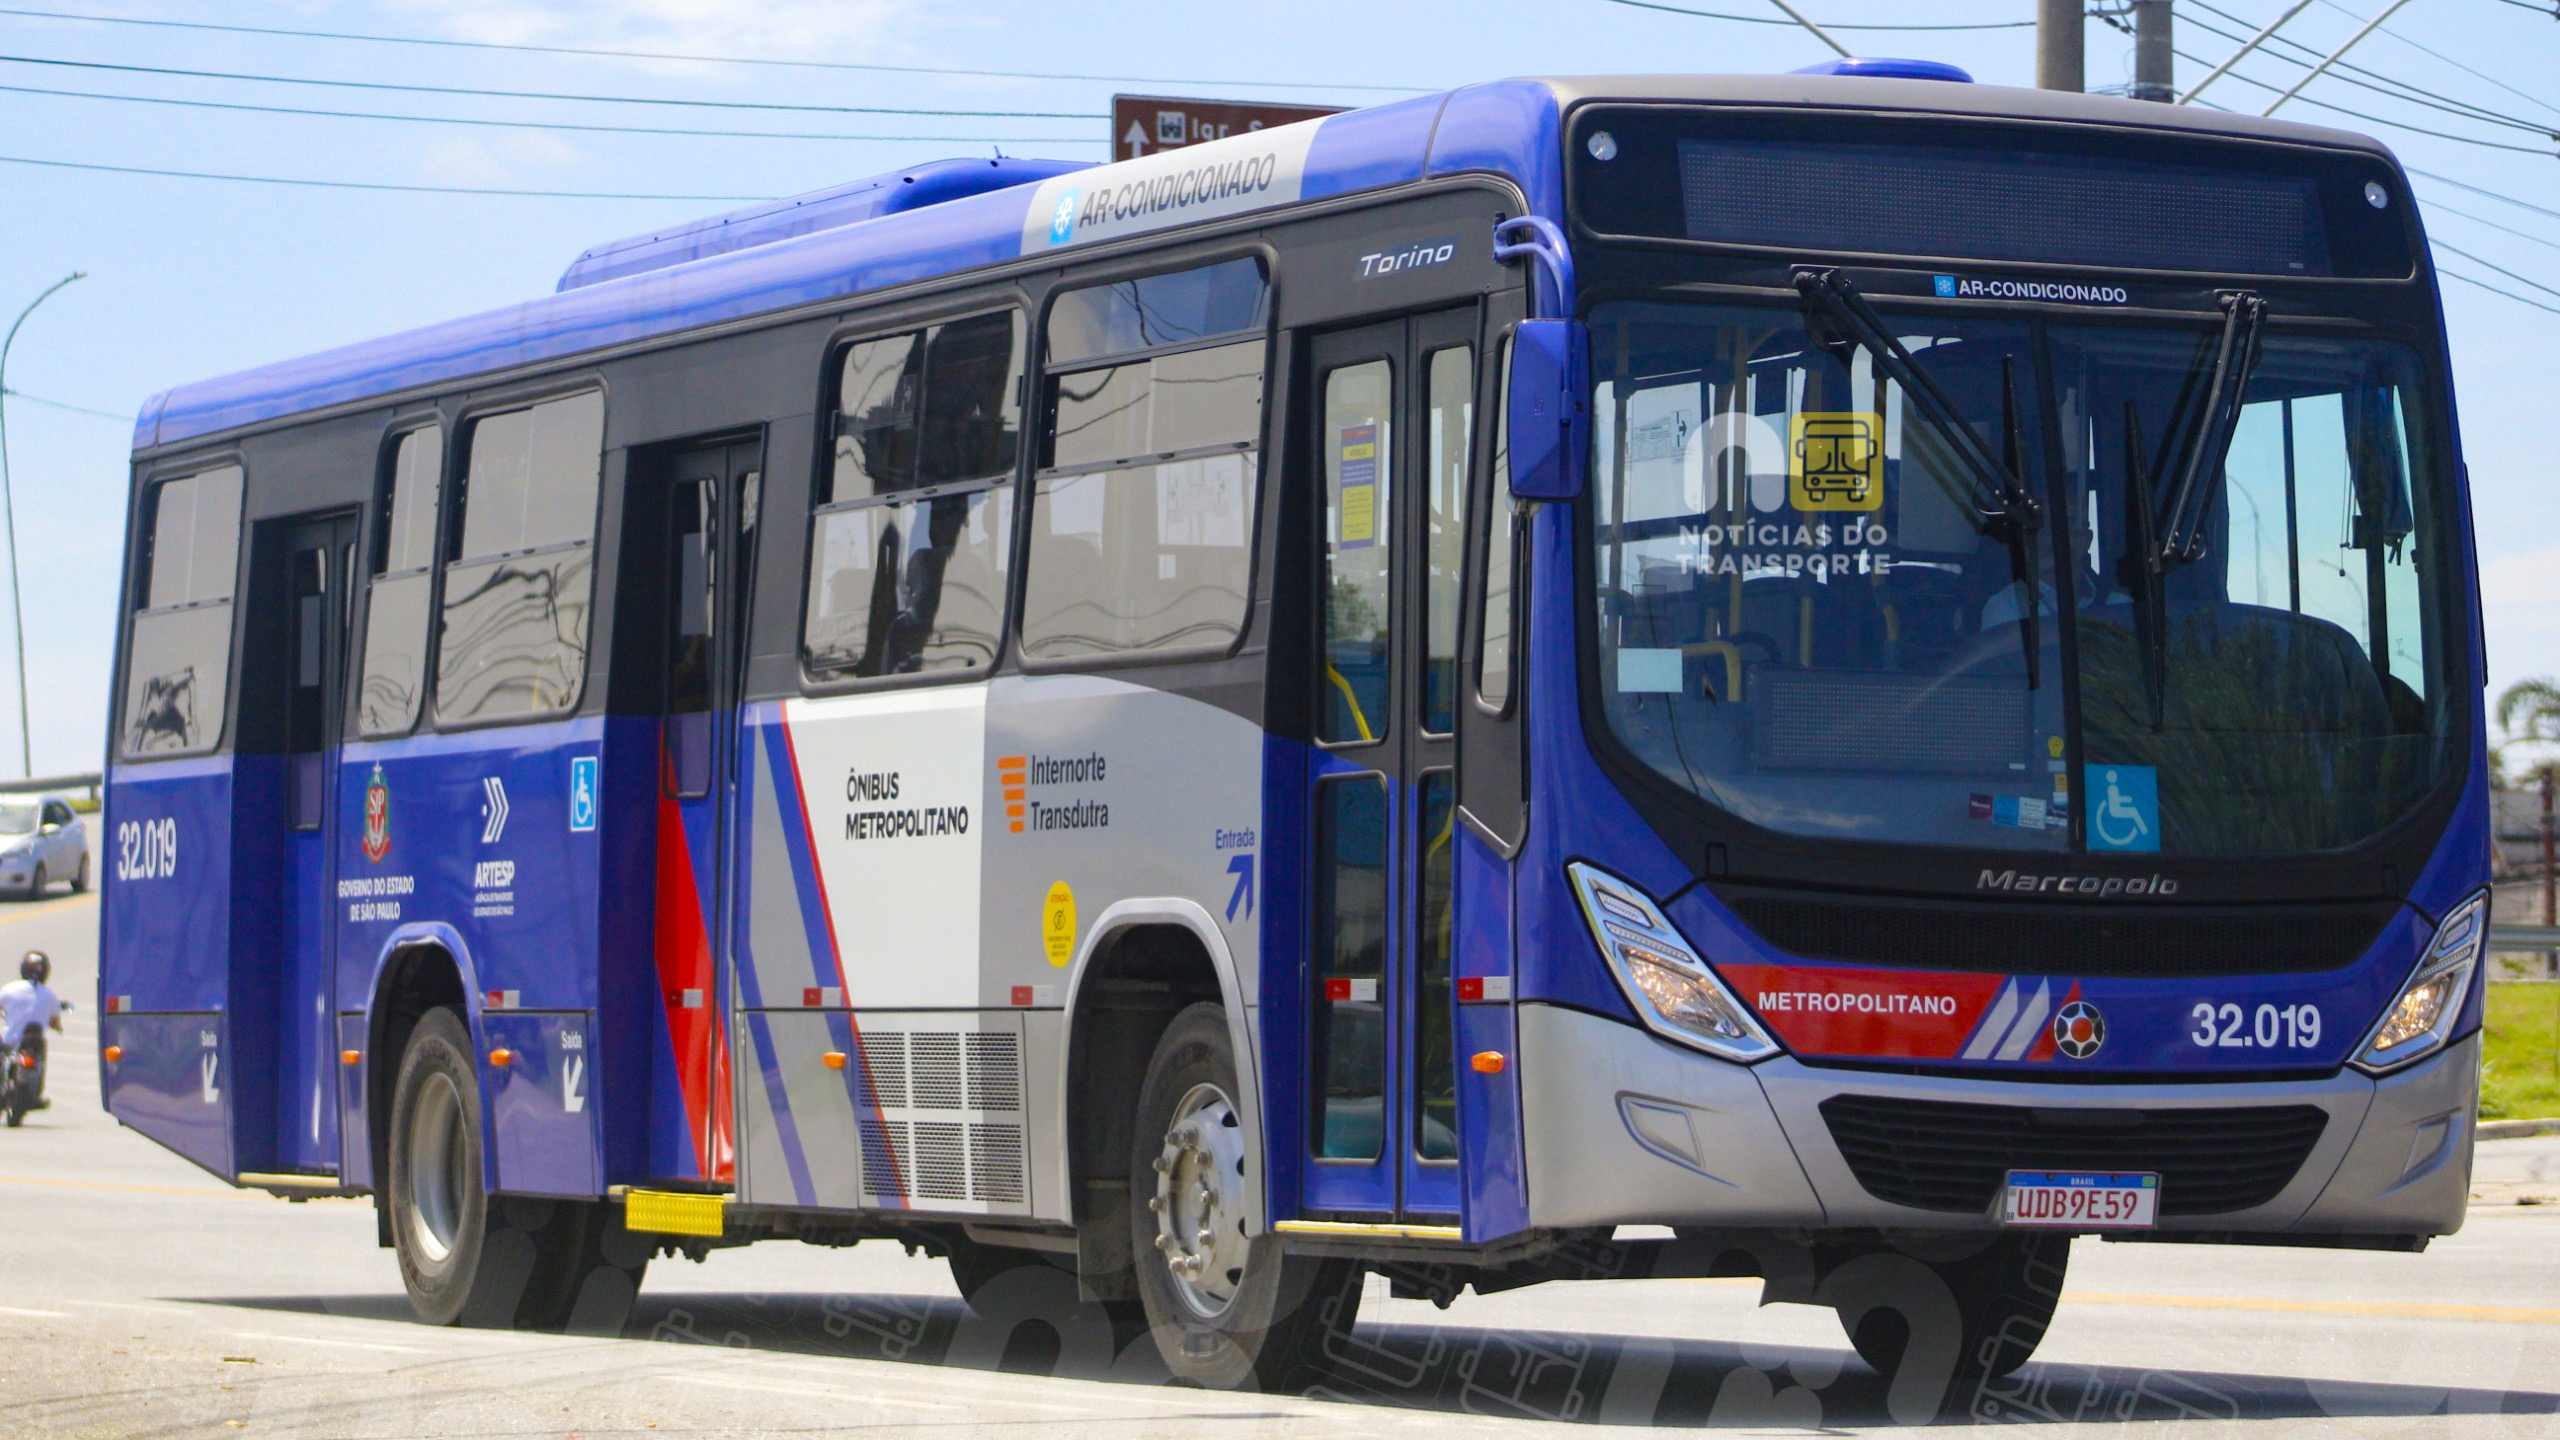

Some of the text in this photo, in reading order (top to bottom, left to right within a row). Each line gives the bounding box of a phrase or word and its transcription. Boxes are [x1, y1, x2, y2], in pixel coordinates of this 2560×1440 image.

[1079, 152, 1276, 228] AR-CONDICIONADO
[1361, 243, 1454, 277] Torino
[1958, 279, 2127, 304] AR-CONDICIONADO
[1031, 752, 1106, 785] Internorte
[847, 768, 900, 802] ÔNIBUS
[846, 806, 969, 840] METROPOLITANO
[1031, 800, 1109, 832] Transdutra
[118, 817, 177, 880] 32.019
[1215, 828, 1255, 850] Entrada
[338, 875, 415, 898] GOVERNO DO ESTADO
[475, 860, 515, 888] ARTESP
[1977, 868, 2179, 898] Marcopolo
[350, 899, 401, 922] DE SÃO PAULO
[1758, 991, 1957, 1015] METROPOLITANO
[2191, 1002, 2322, 1048] 32.019
[2070, 1177, 2094, 1186] BRASIL
[2006, 1211, 2015, 1221] BR
[2017, 1189, 2138, 1220] UDB9E59
